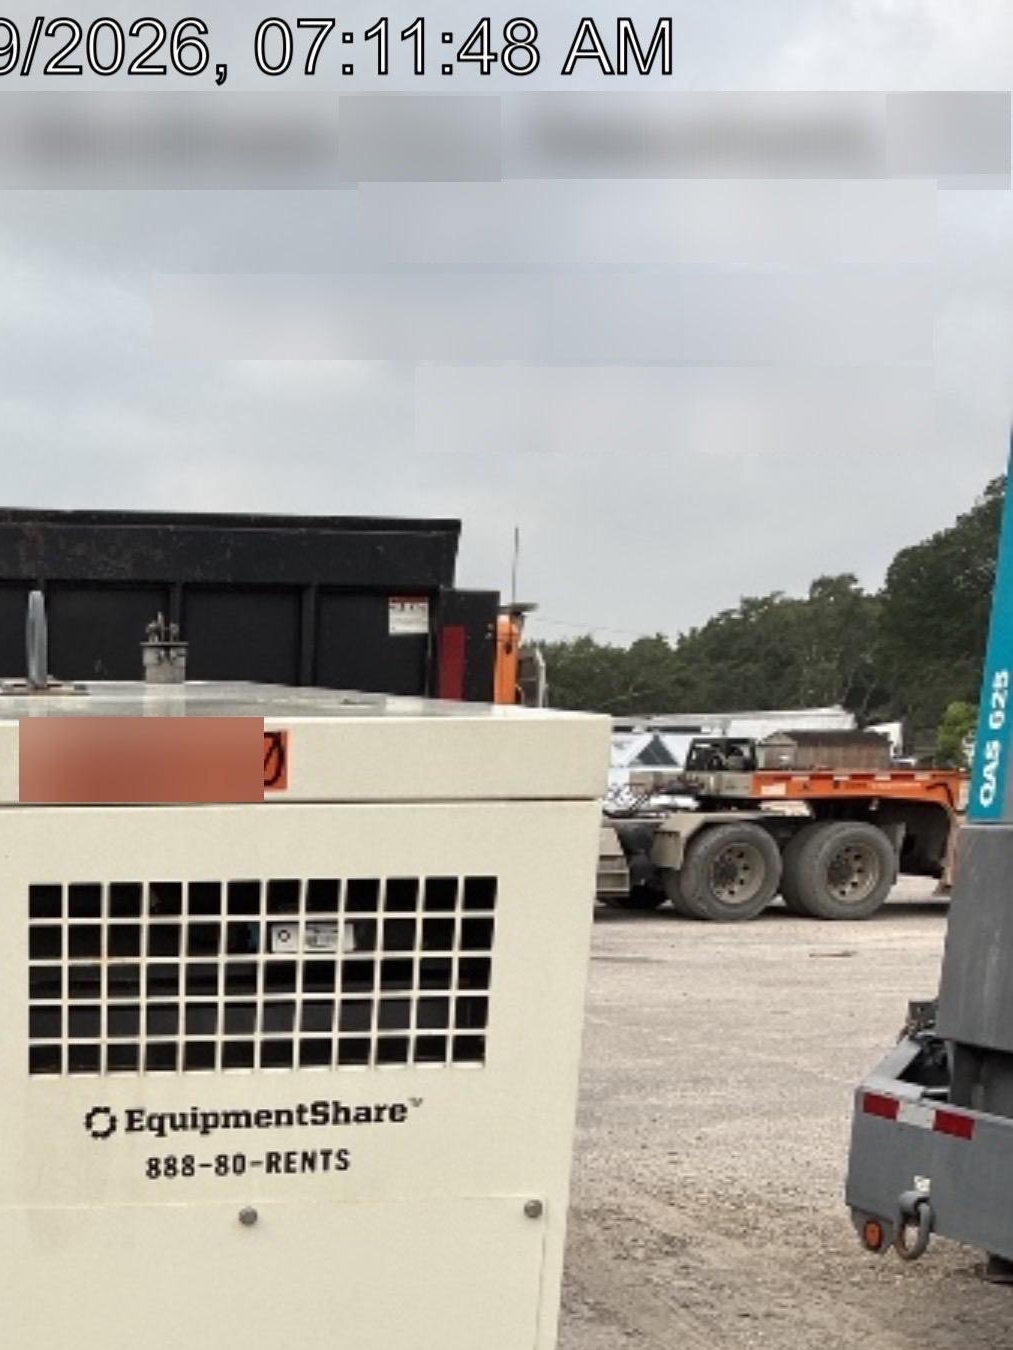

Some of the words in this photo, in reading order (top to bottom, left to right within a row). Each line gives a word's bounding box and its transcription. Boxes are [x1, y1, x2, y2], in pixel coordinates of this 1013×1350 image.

[980, 739, 1001, 808] QAS
[124, 1100, 408, 1137] EquipmentShare
[145, 1149, 351, 1180] 888-80-RENTS
